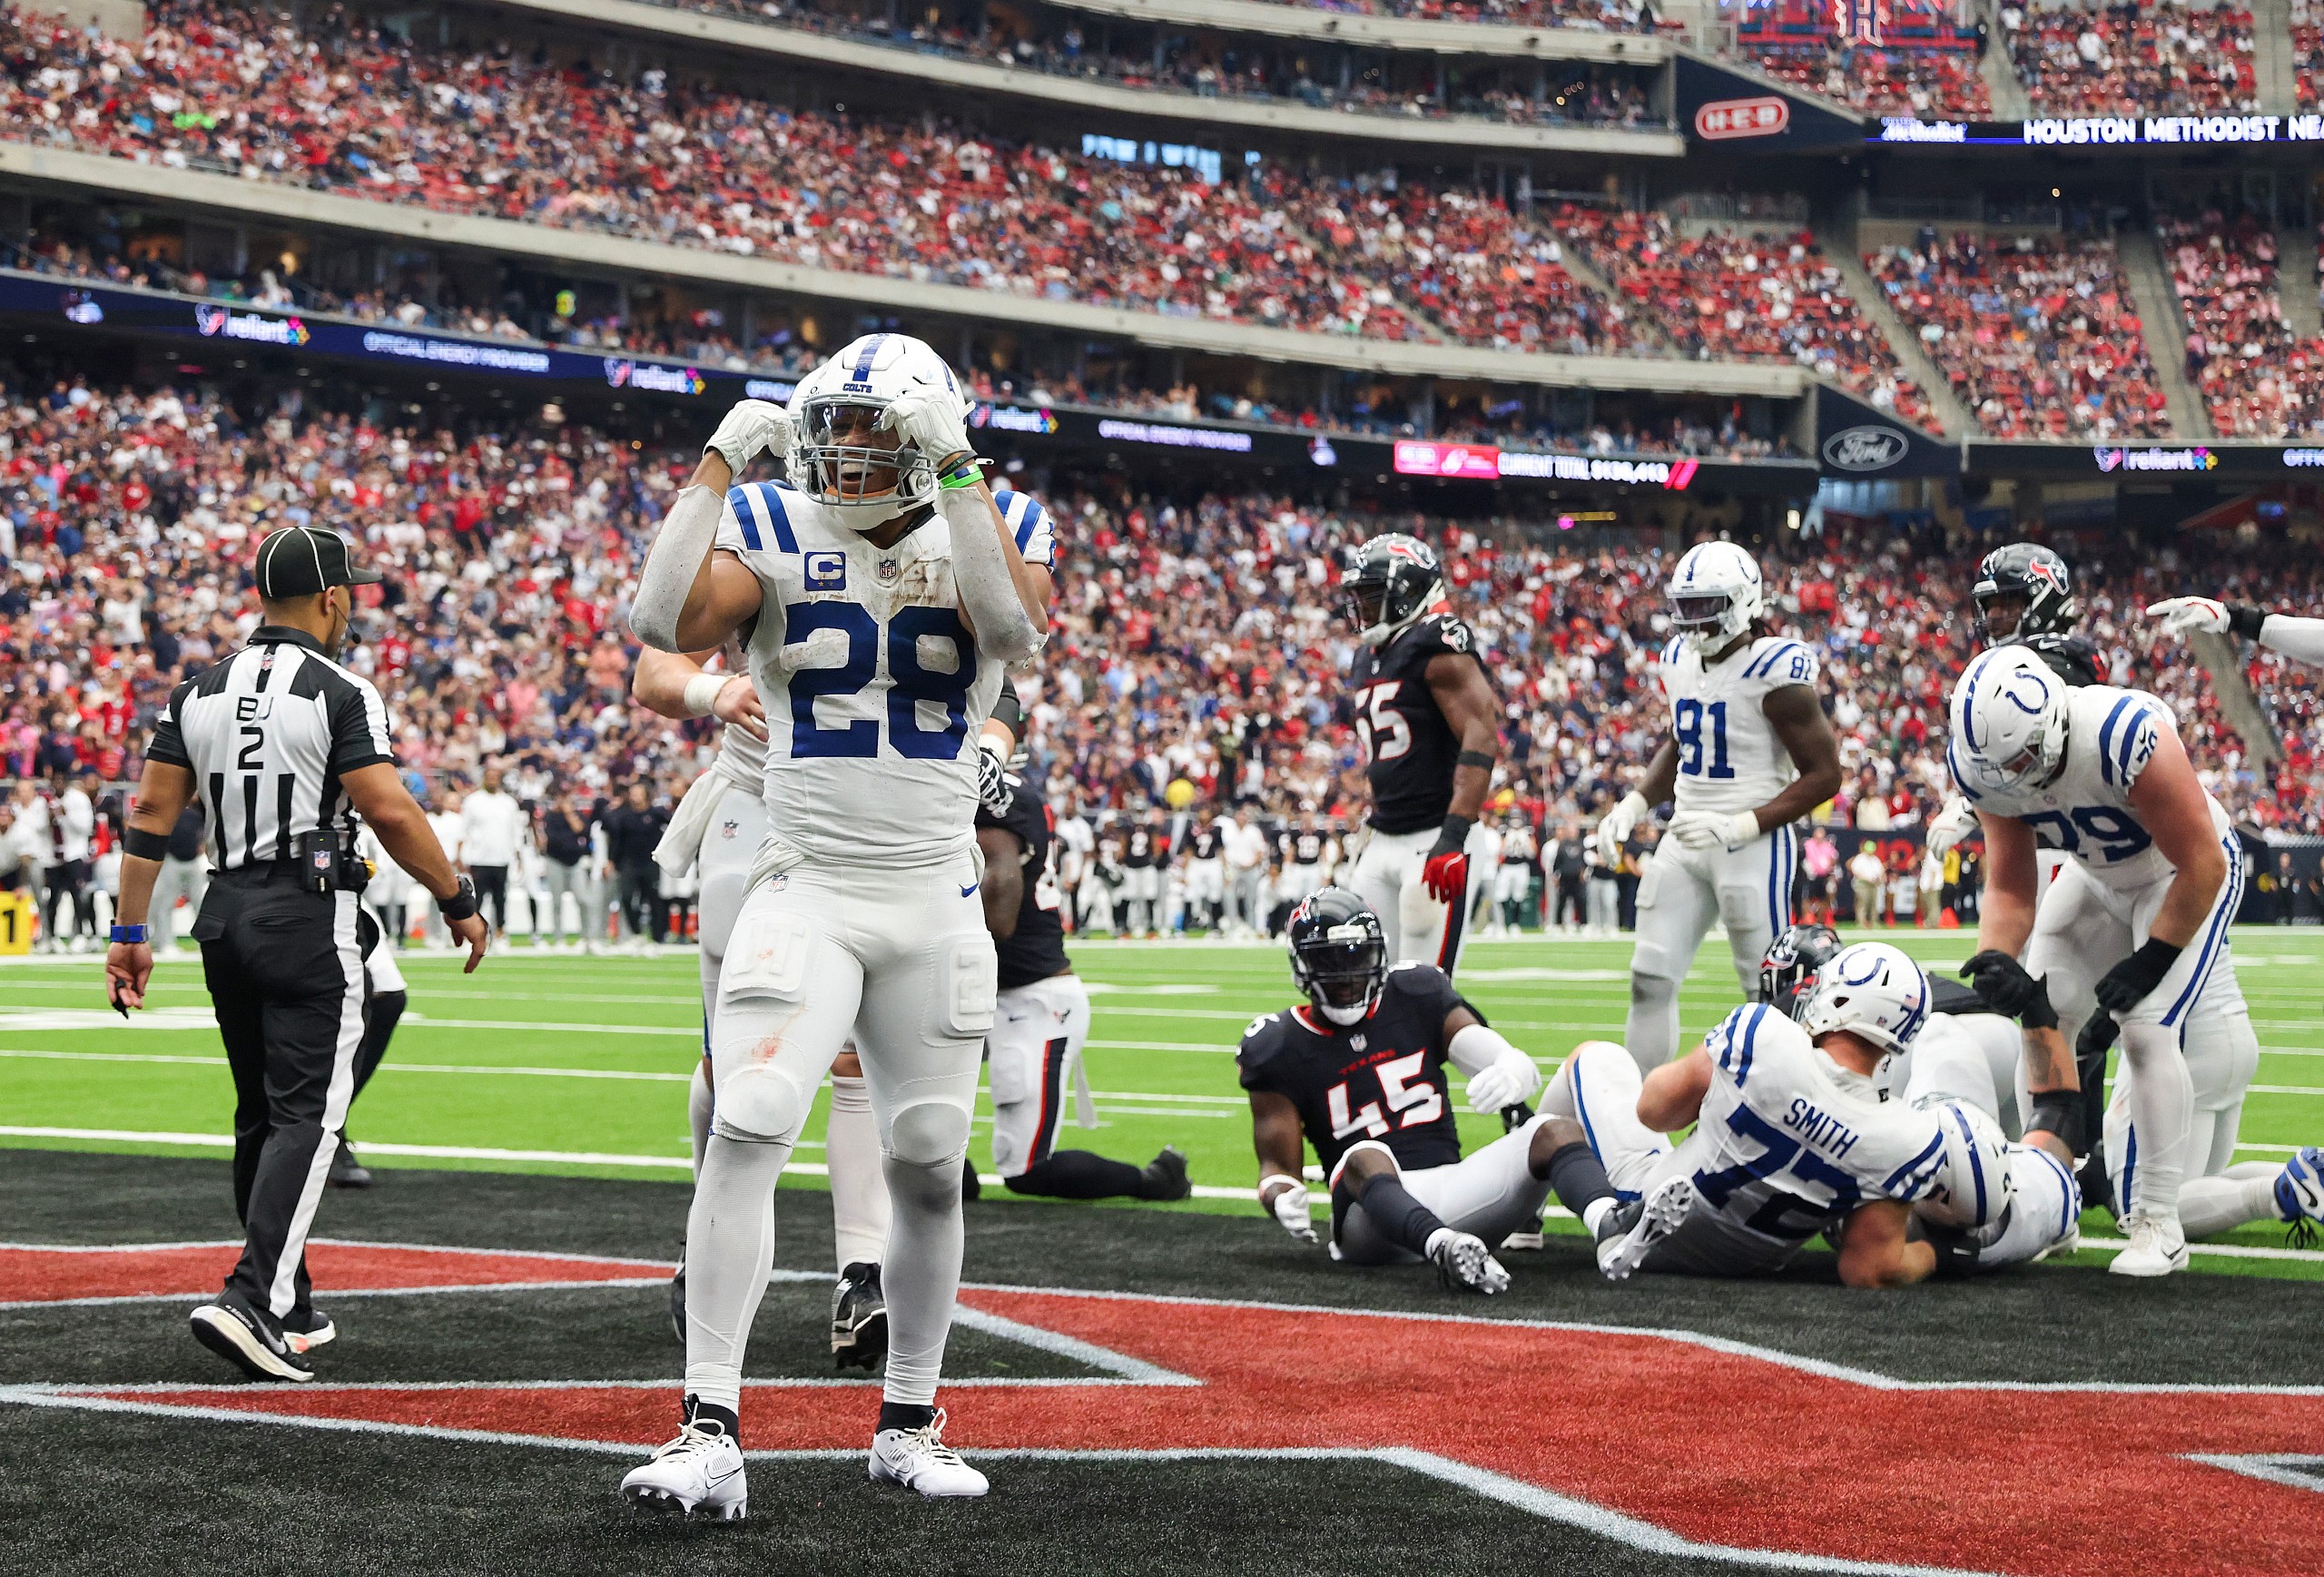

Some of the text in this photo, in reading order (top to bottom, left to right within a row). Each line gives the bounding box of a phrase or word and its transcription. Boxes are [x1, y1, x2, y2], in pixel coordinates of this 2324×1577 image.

[2024, 118, 2136, 144] HOUSTON
[2144, 115, 2280, 143] METHODIST
[842, 382, 872, 394] COLTS
[1838, 433, 1892, 464] Ford
[2128, 447, 2197, 470] reliant
[808, 554, 843, 580] C
[783, 599, 977, 760] 28
[1790, 656, 1813, 680] 81
[236, 696, 274, 721] BJ
[238, 726, 264, 770] 2
[1676, 698, 1735, 779] 81
[3, 910, 15, 942] 1
[1326, 1048, 1443, 1141] 45
[1783, 1099, 1859, 1160] SMITH
[1692, 1101, 1862, 1242] 72
